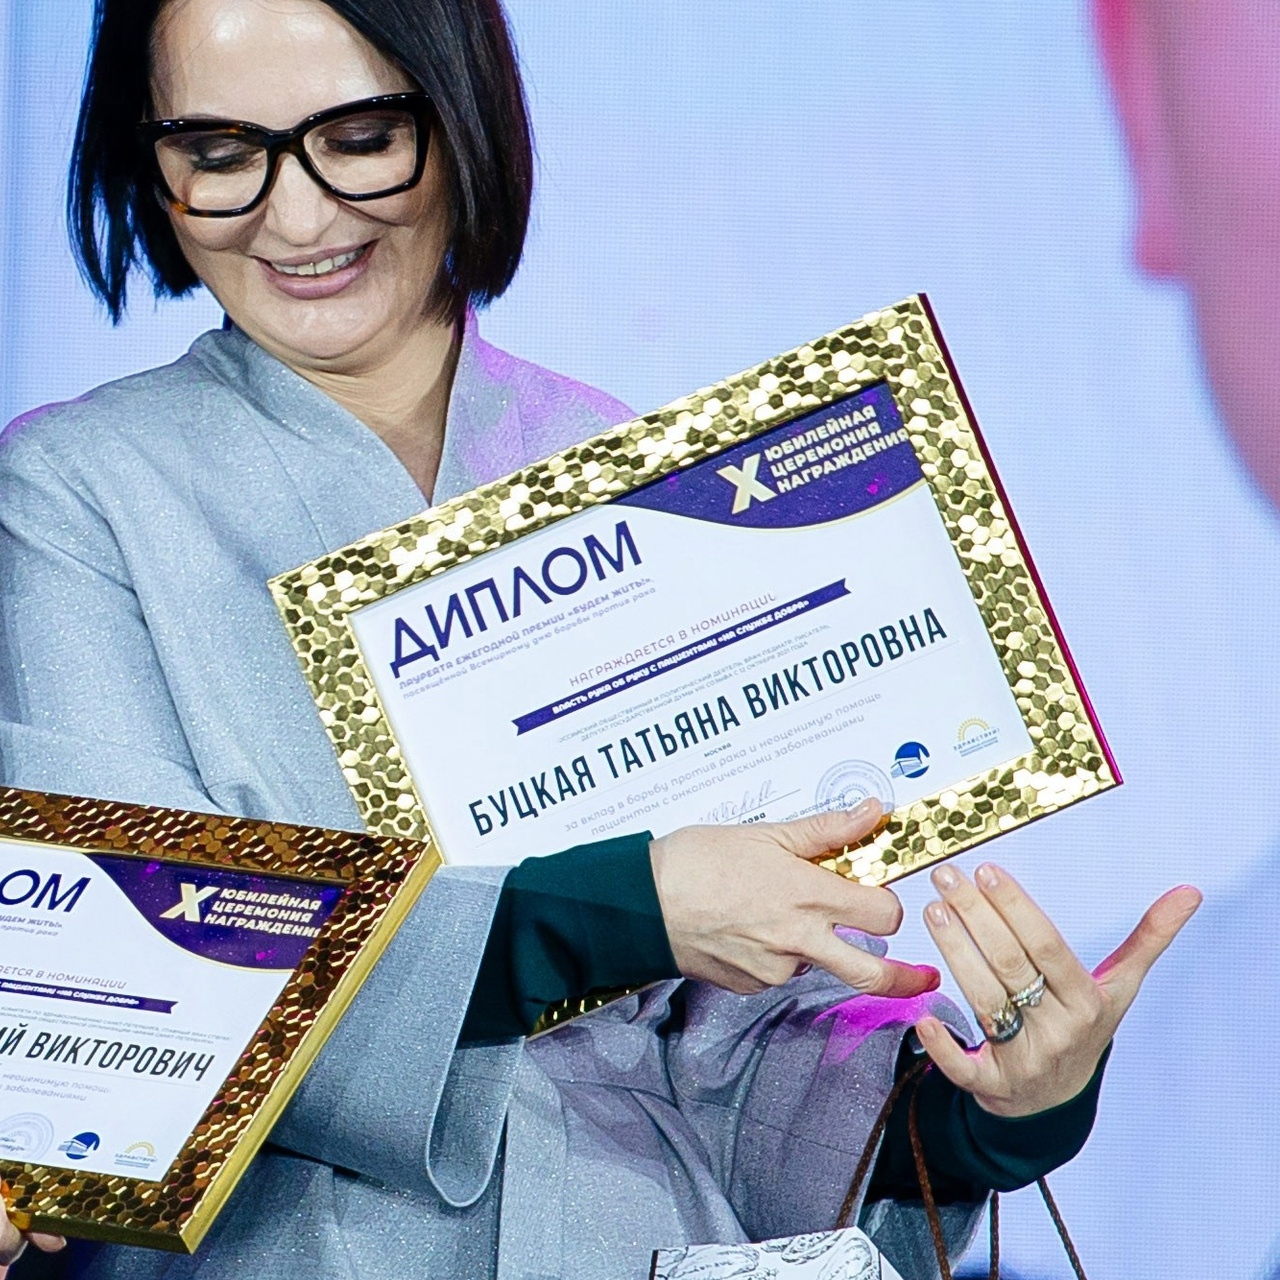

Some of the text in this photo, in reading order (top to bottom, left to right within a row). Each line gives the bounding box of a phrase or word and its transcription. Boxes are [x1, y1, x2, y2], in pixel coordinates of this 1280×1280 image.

[763, 404, 877, 462] ЮБИЛЕЙНАЯ
[770, 421, 882, 478] ЦЕРЕМОНИЯ
[775, 427, 910, 494] НАГРАЖДЕНИЯ
[389, 520, 643, 679] ДИПЛОМ
[552, 600, 810, 715] ВЛАСТЬ РУКА ОБ РУКУ С ПАЦИЕНТАМИ «НА СЛУЖБЕ ДОБРА»
[569, 634, 676, 687] НАГРАЖДАЕТСЯ
[678, 629, 688, 641] В
[468, 755, 597, 837] БУЦКАЯ
[597, 695, 741, 779] ТАТЬЯНА
[742, 607, 948, 719] ВИКТОРОВНА
[564, 693, 882, 832] за вклад в борьбу против рака и неоценимую помощь
[590, 801, 660, 836] пациентам
[662, 797, 670, 806] с
[670, 753, 773, 802] онкологическими
[774, 714, 865, 758] заболеваниями
[211, 900, 314, 924] ЦЕРЕМОНИЯ
[219, 888, 323, 911] ЮБИЛЕЙНАЯ
[35, 970, 45, 979] В
[46, 972, 127, 990] НОМИНАЦИИ
[24, 1031, 215, 1082] ВИКТОРОВИЧ
